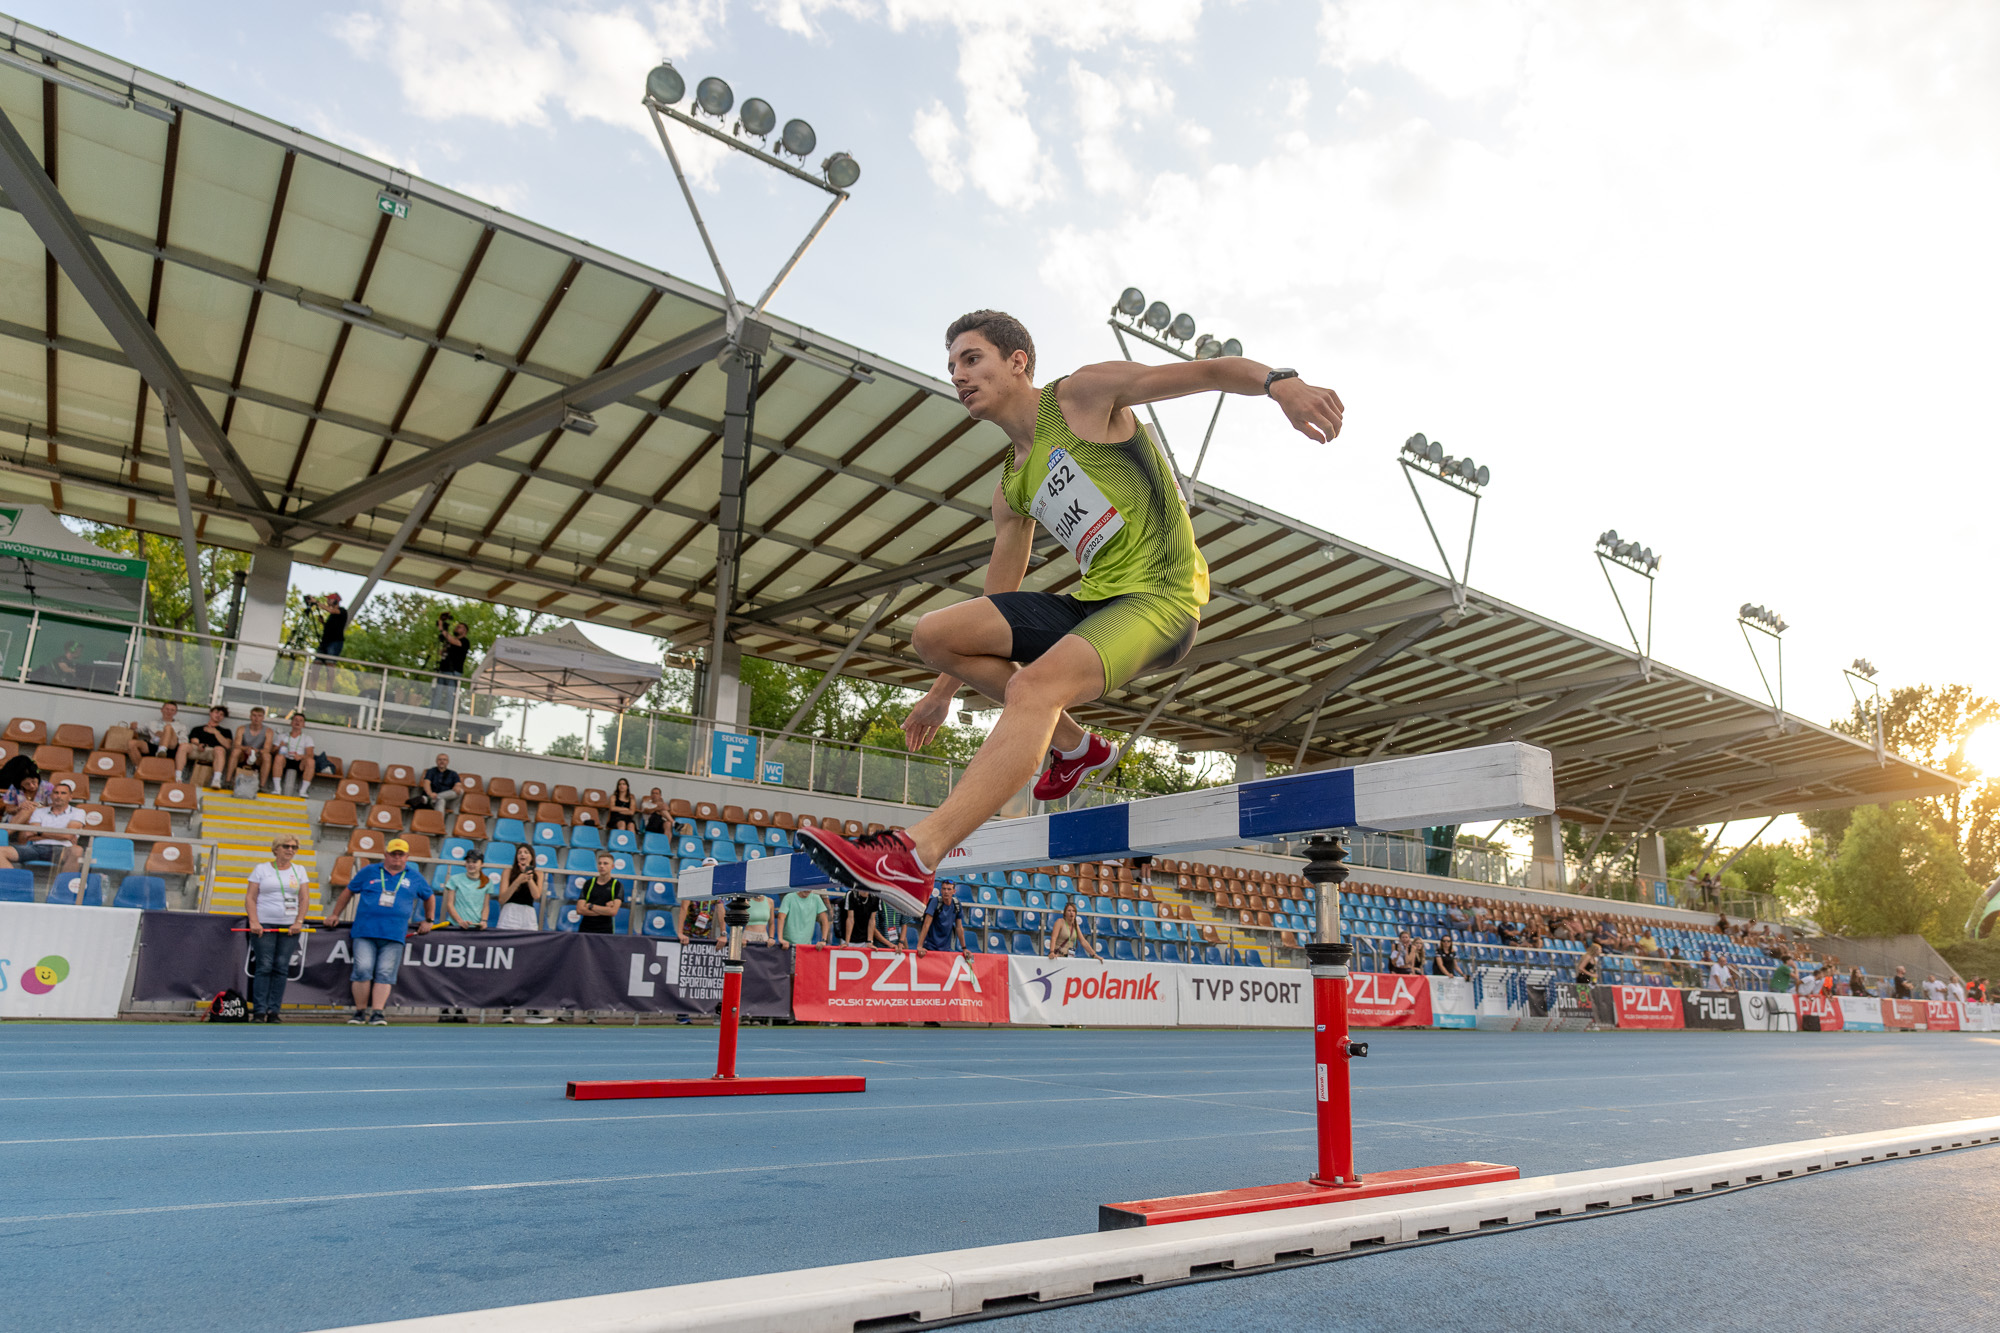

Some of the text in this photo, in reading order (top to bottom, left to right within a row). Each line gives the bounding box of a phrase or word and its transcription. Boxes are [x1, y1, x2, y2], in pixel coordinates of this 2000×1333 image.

[1047, 465, 1076, 498] 452
[1088, 512, 1112, 537] Polski U20
[1089, 533, 1104, 551] 2023
[61, 553, 128, 572] LUBELSKIEGO
[721, 734, 749, 745] SEKTOR
[724, 744, 745, 773] F
[765, 764, 782, 775] WC
[1656, 887, 1666, 904] H
[402, 942, 515, 970] LUBLIN
[680, 965, 725, 978] SZKOLENI
[828, 950, 982, 993] PZLA
[679, 988, 723, 1000] W LUBLINI
[1192, 978, 1302, 1004] TVP SPORT
[1621, 987, 1673, 1012] PZLA
[1687, 990, 1701, 1005] 4F
[828, 998, 983, 1008] POLSKI ZWIĄZEK LEKKIEJ ATLETYKI
[1700, 997, 1736, 1020] FUEL
[1799, 997, 1835, 1017] PZLA
[1928, 1002, 1955, 1018] PZLA
